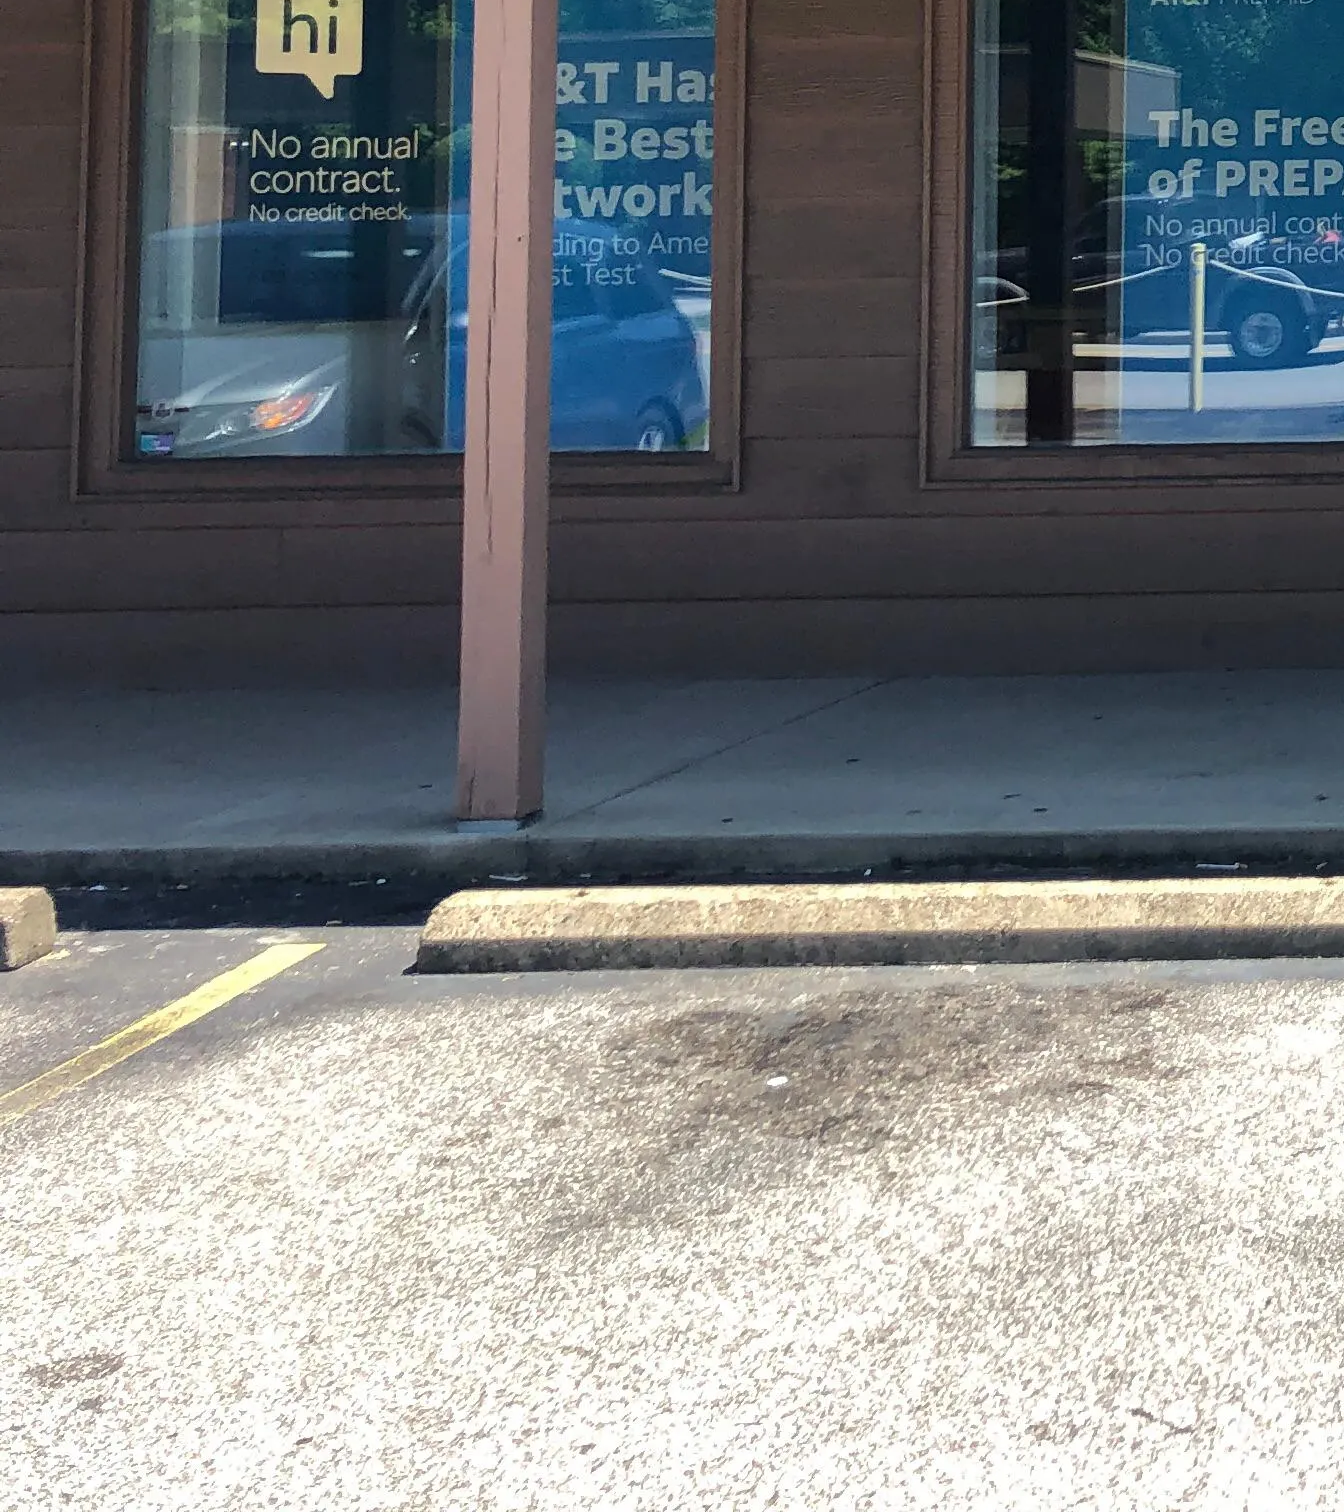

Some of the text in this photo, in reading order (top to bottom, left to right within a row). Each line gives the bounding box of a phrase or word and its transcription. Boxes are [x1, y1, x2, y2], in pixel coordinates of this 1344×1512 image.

[556, 61, 620, 104] &T
[251, 128, 419, 159] No annual
[594, 119, 714, 160] Best
[1149, 108, 1239, 148] The
[250, 166, 401, 194] contract.
[1149, 158, 1203, 199] of
[554, 172, 713, 219] twork
[249, 201, 412, 222] No credit check.
[1146, 214, 1183, 237] No
[1191, 211, 1277, 236] annual
[611, 235, 640, 255] to
[648, 232, 709, 255] Ame
[1144, 243, 1183, 266] No
[1192, 241, 1268, 265] credit
